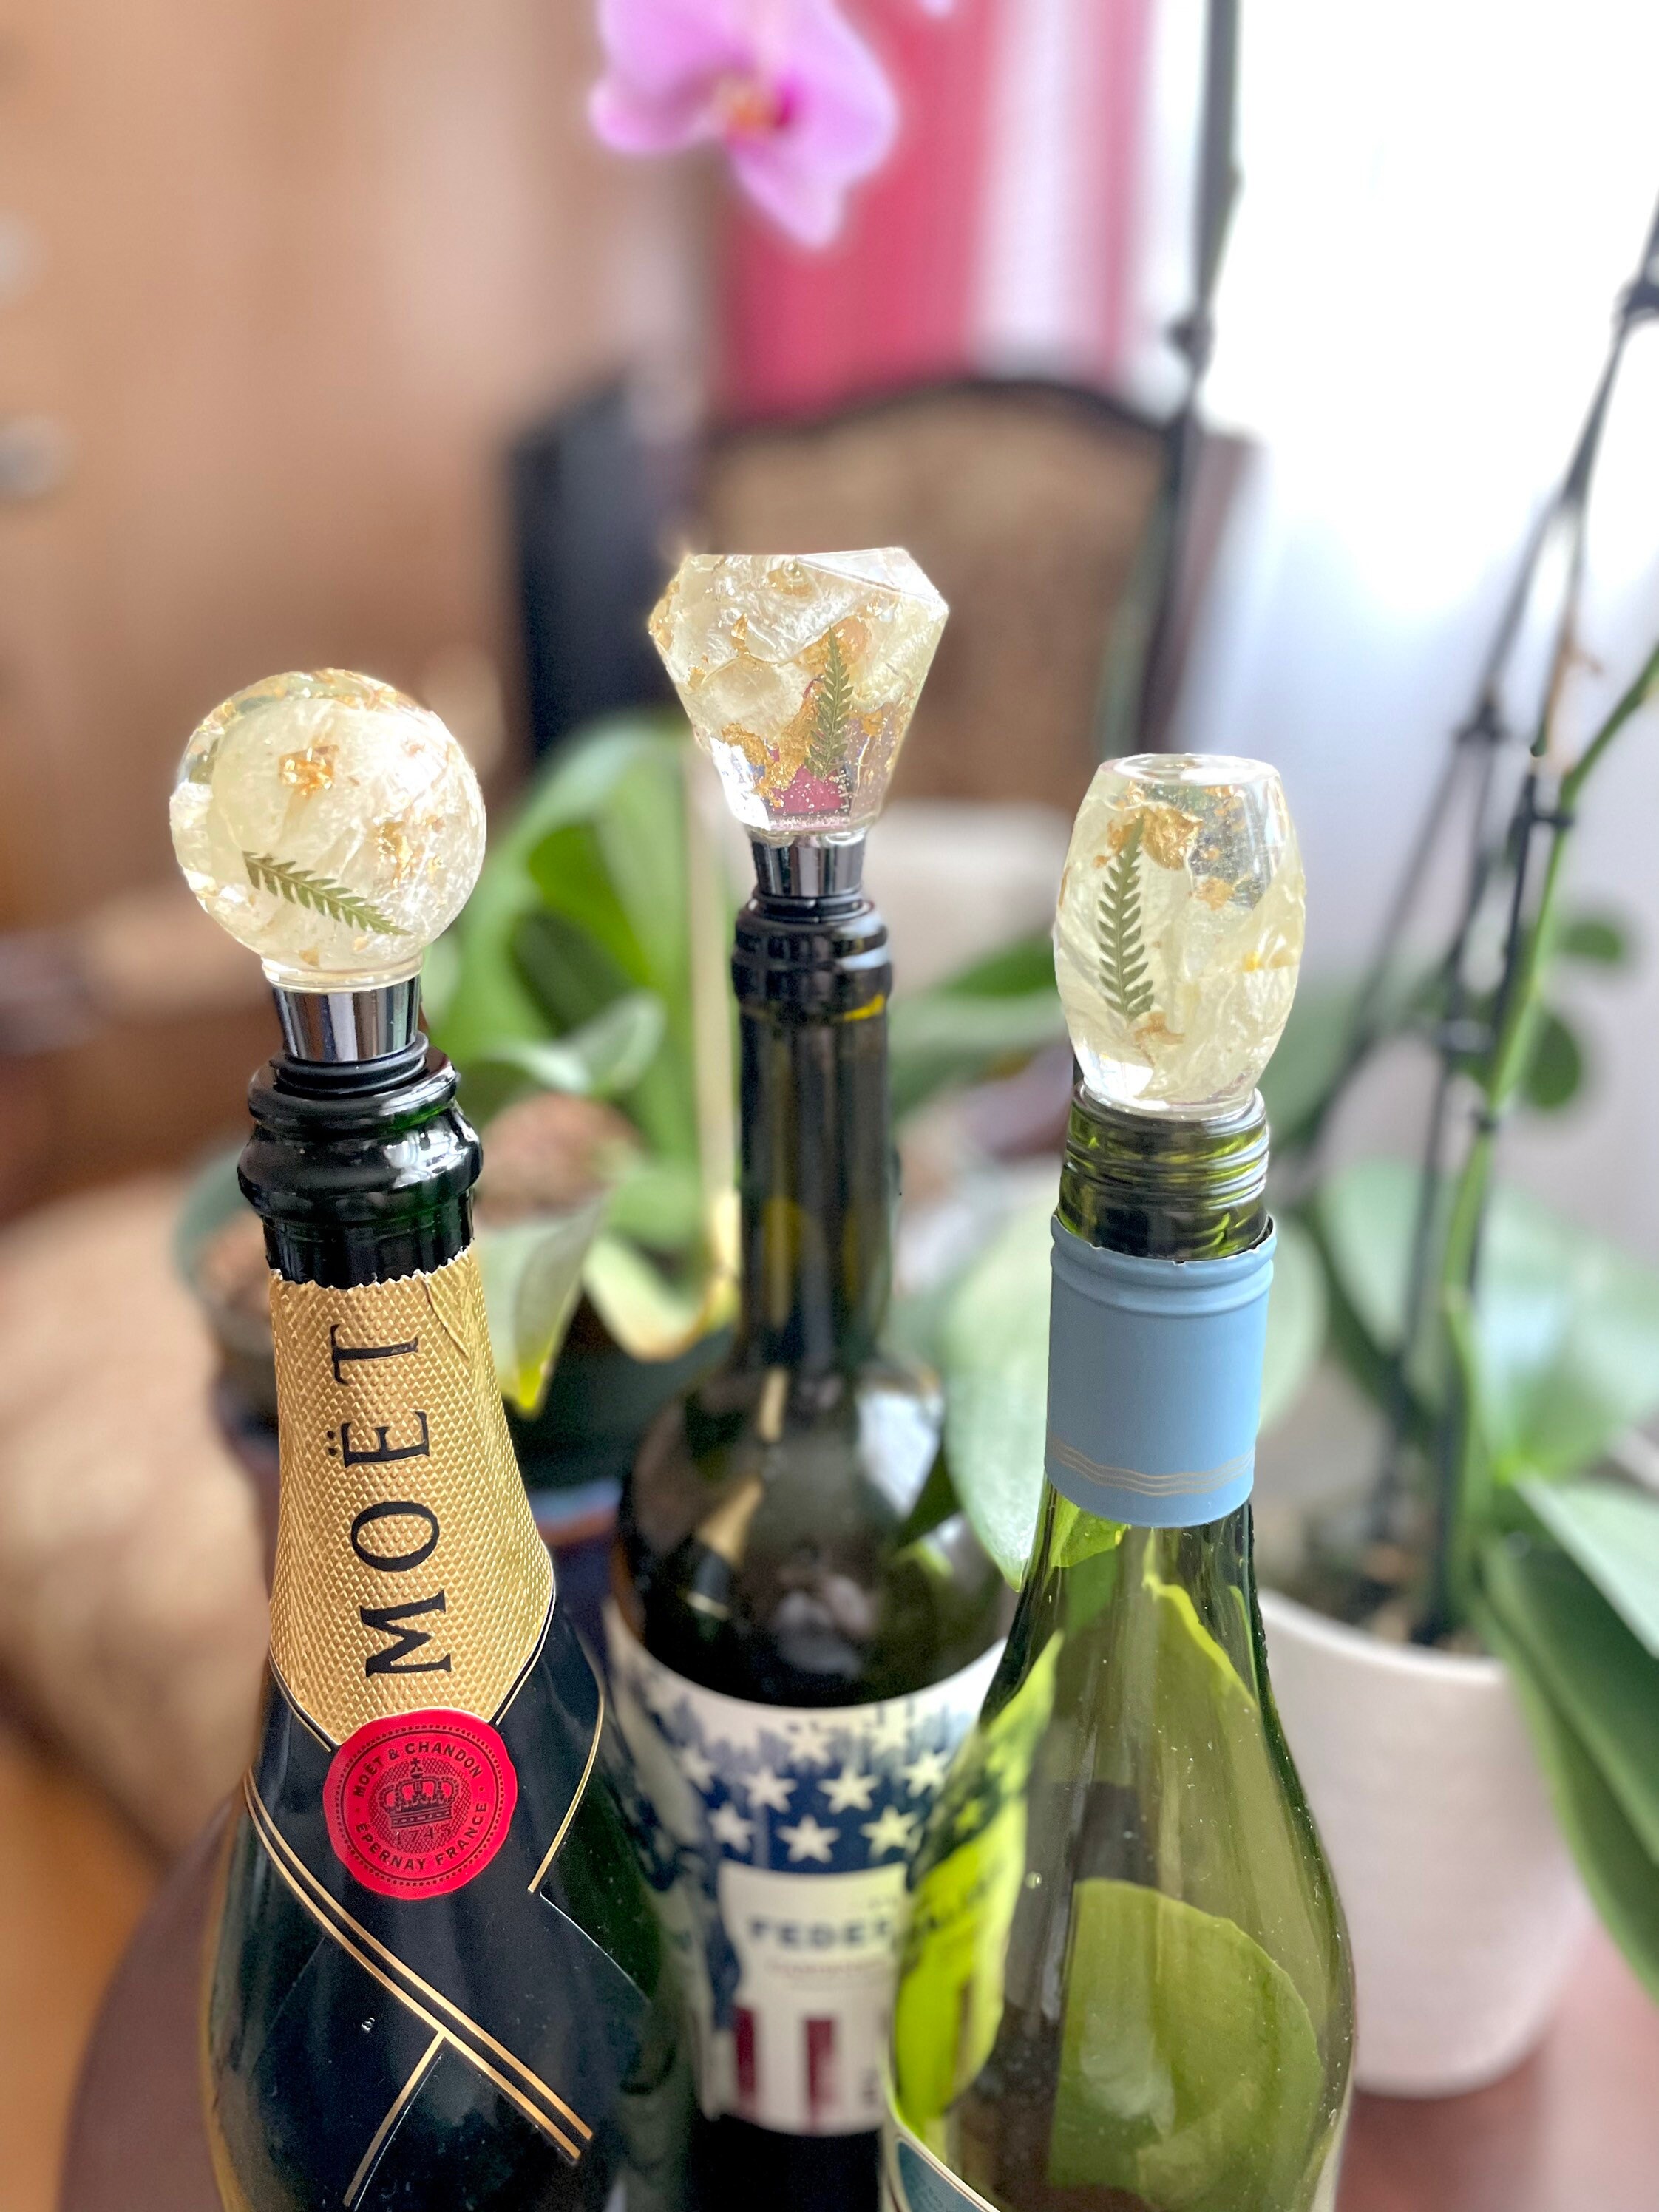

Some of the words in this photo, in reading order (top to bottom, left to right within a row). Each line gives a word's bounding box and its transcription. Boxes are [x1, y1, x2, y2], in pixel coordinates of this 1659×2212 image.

[328, 1323, 452, 1677] MOËT
[388, 1749, 400, 1760] &
[405, 1740, 482, 1778] CHANDON
[356, 1823, 427, 1870] EPERNAY
[435, 1802, 486, 1865] FRANCE
